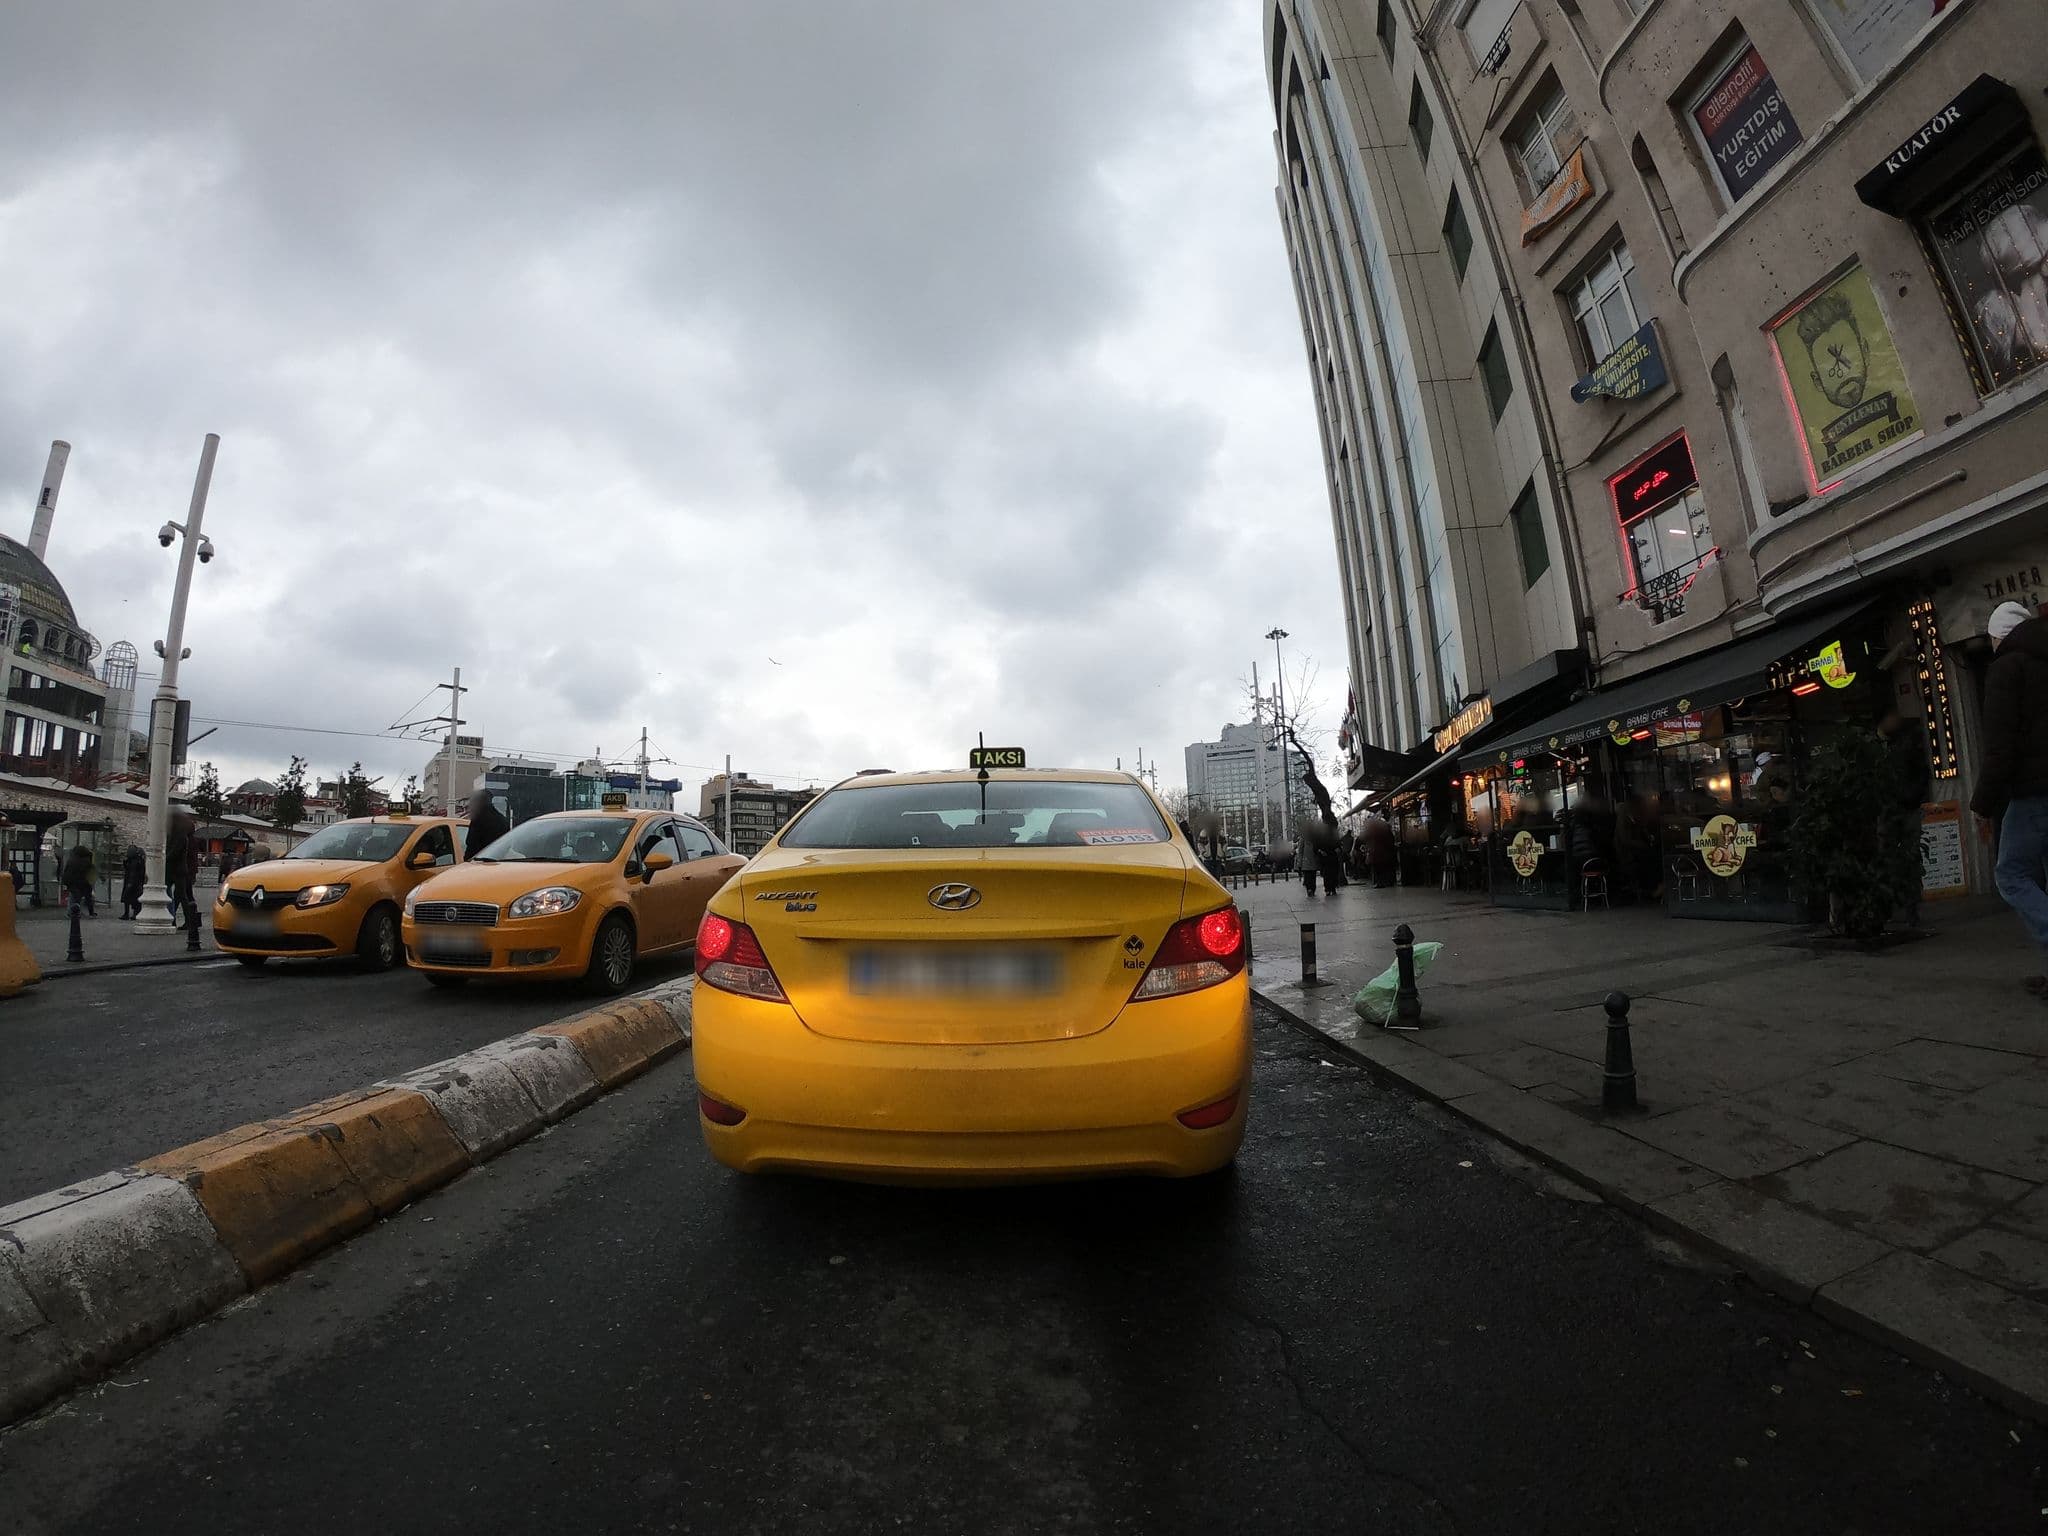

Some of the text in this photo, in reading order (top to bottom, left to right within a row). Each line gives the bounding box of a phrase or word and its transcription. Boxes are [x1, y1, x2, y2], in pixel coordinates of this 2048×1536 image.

[1706, 57, 1754, 119] alternatif
[1717, 90, 1784, 163] YURTDIŞI
[1885, 105, 1961, 174] KUAFÖR
[1735, 120, 1787, 178] EĞİTİM
[1946, 220, 1975, 248] HAIR
[1977, 168, 2048, 224] EXTENSION
[1821, 416, 1914, 473] BARBER SHOP
[1983, 567, 2041, 599] TANER
[1651, 706, 1669, 720] CAFE
[1091, 834, 1154, 844] ALO 153
[1736, 835, 1754, 846] CAFE
[754, 890, 819, 901] ACCENT
[1123, 958, 1146, 969] kale
